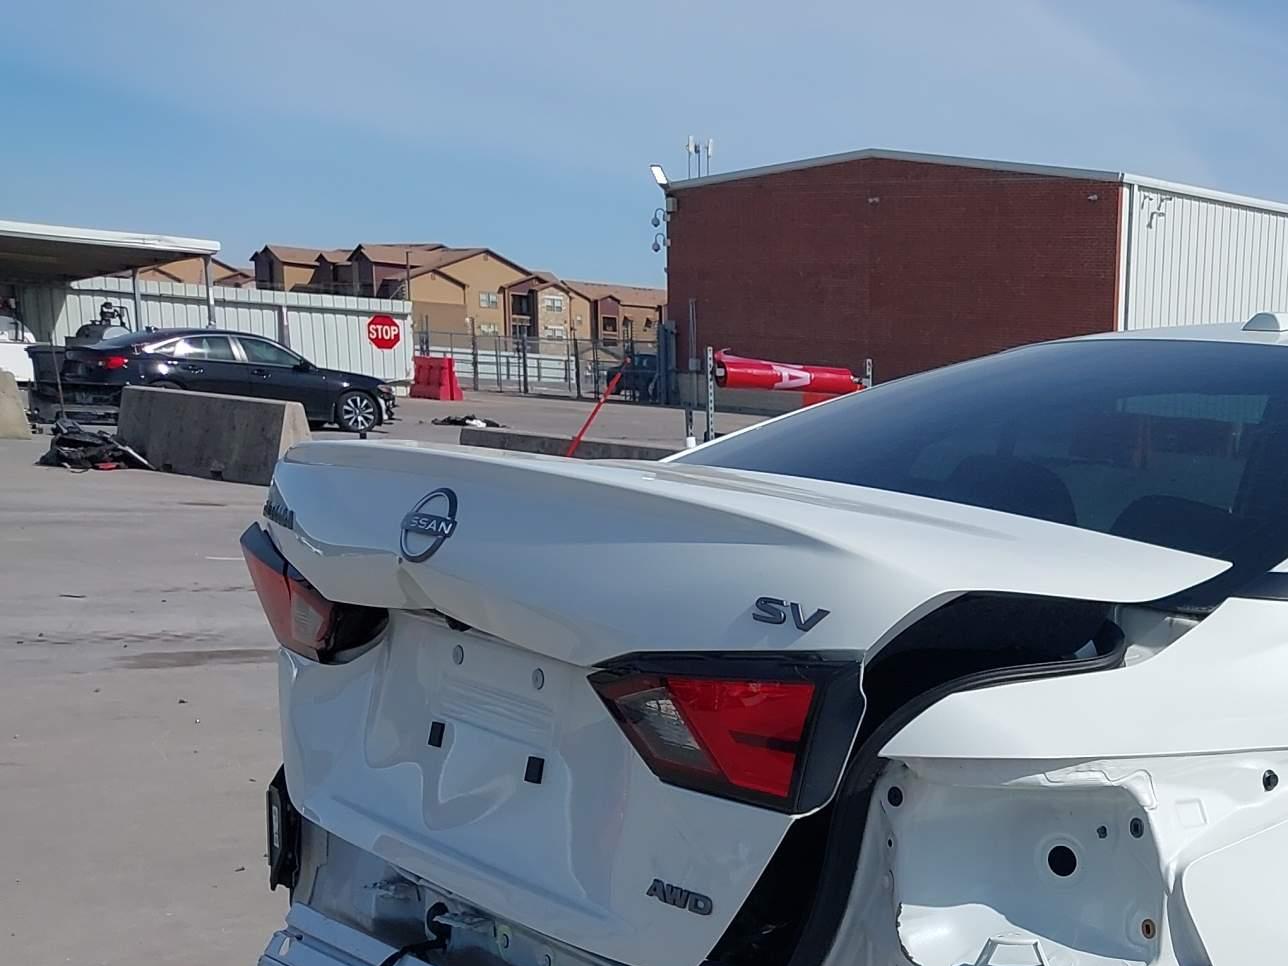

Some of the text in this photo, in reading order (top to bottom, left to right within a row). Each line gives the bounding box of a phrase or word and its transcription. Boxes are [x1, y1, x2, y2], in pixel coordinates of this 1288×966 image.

[369, 325, 399, 340] STOP
[752, 596, 831, 632] SV
[646, 878, 713, 915] AWD
